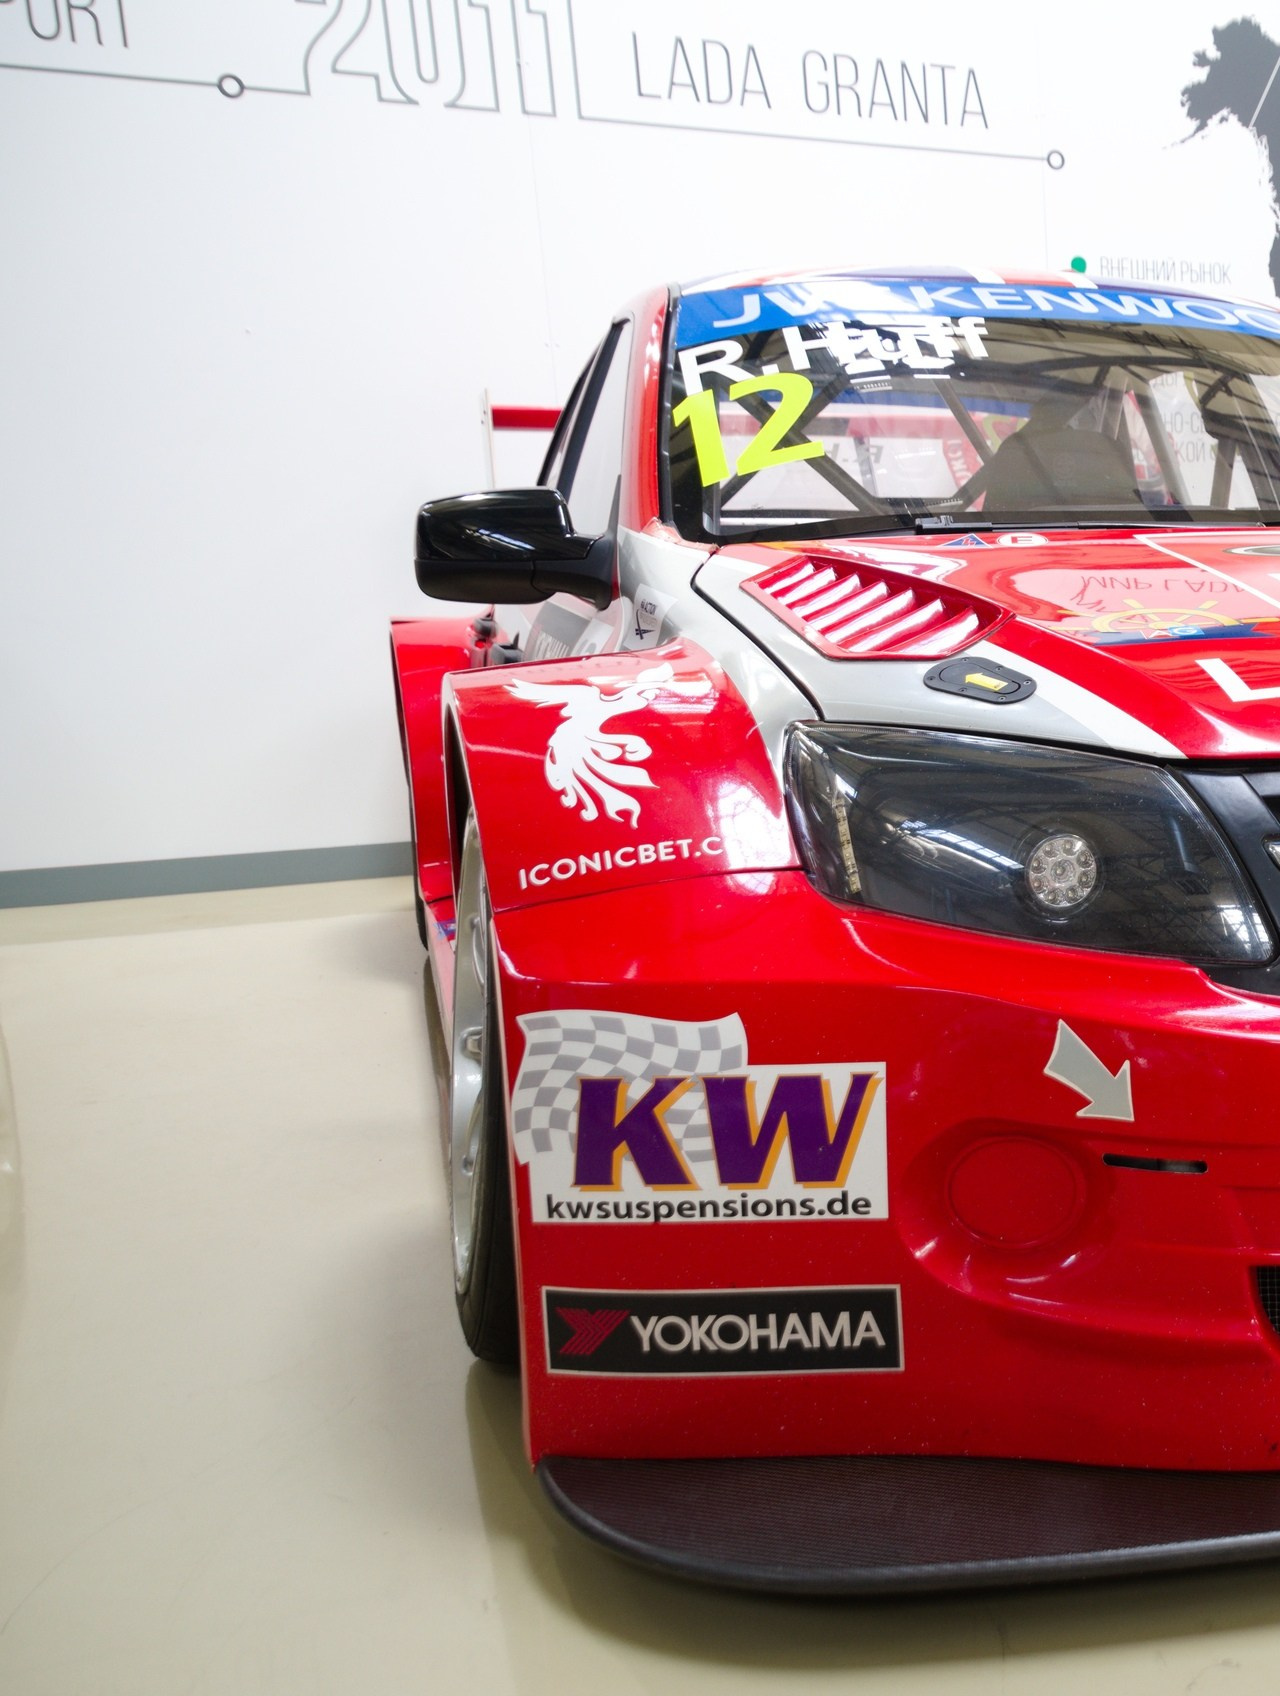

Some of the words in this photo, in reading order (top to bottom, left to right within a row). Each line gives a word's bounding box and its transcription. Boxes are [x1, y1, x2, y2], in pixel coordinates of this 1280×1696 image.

[631, 31, 772, 110] LADA
[800, 49, 989, 130] GRANTA
[1180, 260, 1232, 285] РЫНОК
[672, 372, 825, 488] 12
[569, 1071, 885, 1192] KW
[545, 1190, 872, 1223] kwsuspensions.de
[630, 1310, 887, 1352] YOKOHAMA
